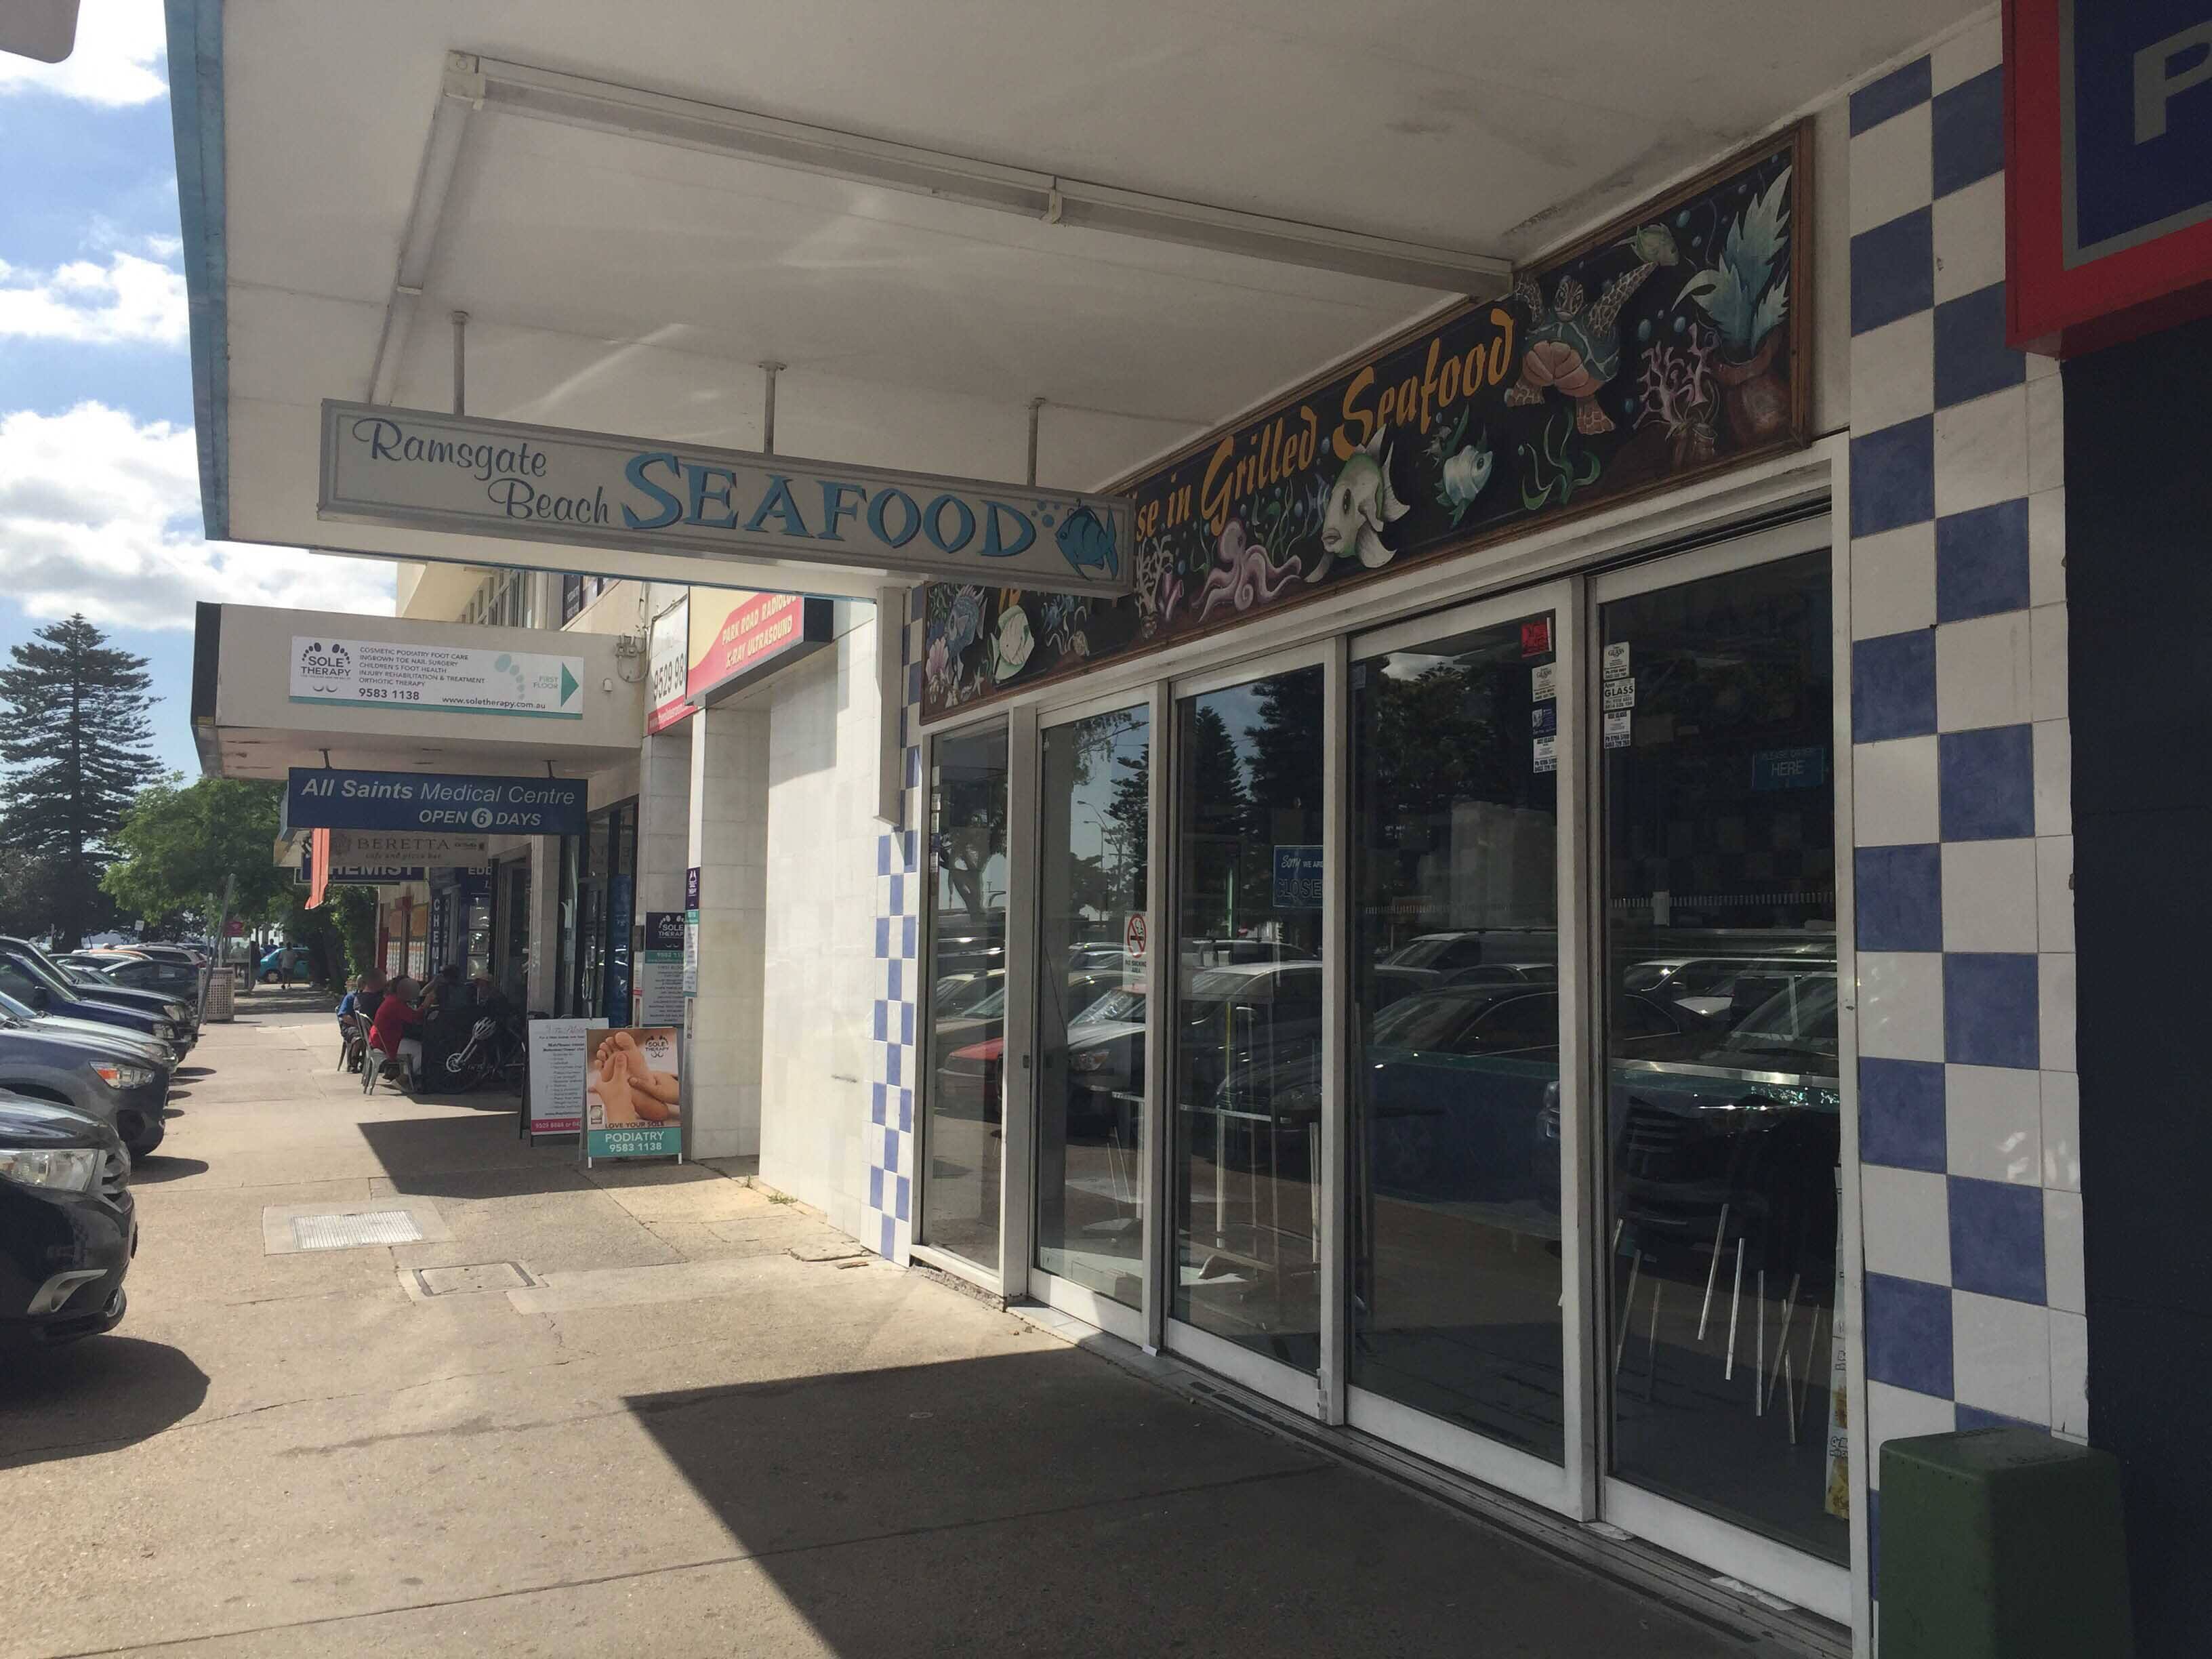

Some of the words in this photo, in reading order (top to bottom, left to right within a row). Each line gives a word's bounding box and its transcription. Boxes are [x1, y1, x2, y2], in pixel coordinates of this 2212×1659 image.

[1135, 498, 1160, 541] se
[1167, 472, 1191, 529] in
[1202, 407, 1317, 537] Grilled
[1333, 308, 1514, 461] Seafood
[352, 417, 547, 481] Ramsgate
[487, 477, 609, 524] Beach
[620, 453, 1036, 558] SEAFOOD
[722, 620, 740, 646] PARK
[741, 609, 759, 635] ROAD
[726, 642, 746, 670] X-RAY
[747, 614, 793, 657] ULTRASOUND
[360, 647, 394, 655] COSMETIC
[308, 656, 344, 668] SOLE
[301, 666, 351, 676] THERAPY
[385, 672, 438, 680] REHABILITATION
[447, 676, 485, 684] TREATMENT
[396, 679, 426, 687] THERAPY
[654, 661, 673, 702] 9529
[359, 688, 388, 698] 9583
[392, 691, 419, 700] 1138
[1605, 686, 1633, 697] GLASS
[442, 697, 546, 709] www.soletherapy.com.au
[1771, 760, 1805, 776] HERE
[301, 779, 334, 796] All
[342, 780, 413, 799] Saints
[420, 783, 500, 803] Medical
[508, 786, 575, 805] Centre
[419, 810, 468, 824] OPEN
[495, 813, 541, 826] DAYS
[357, 838, 450, 850] BERETTA
[1282, 855, 1301, 873] Sorry
[330, 867, 414, 876] HEMIST
[1277, 878, 1323, 898] CLOSE
[432, 898, 441, 977] CHEMI
[605, 1131, 664, 1142] PODIATRY
[609, 1143, 634, 1153] 9583
[638, 1142, 662, 1151] 1138
